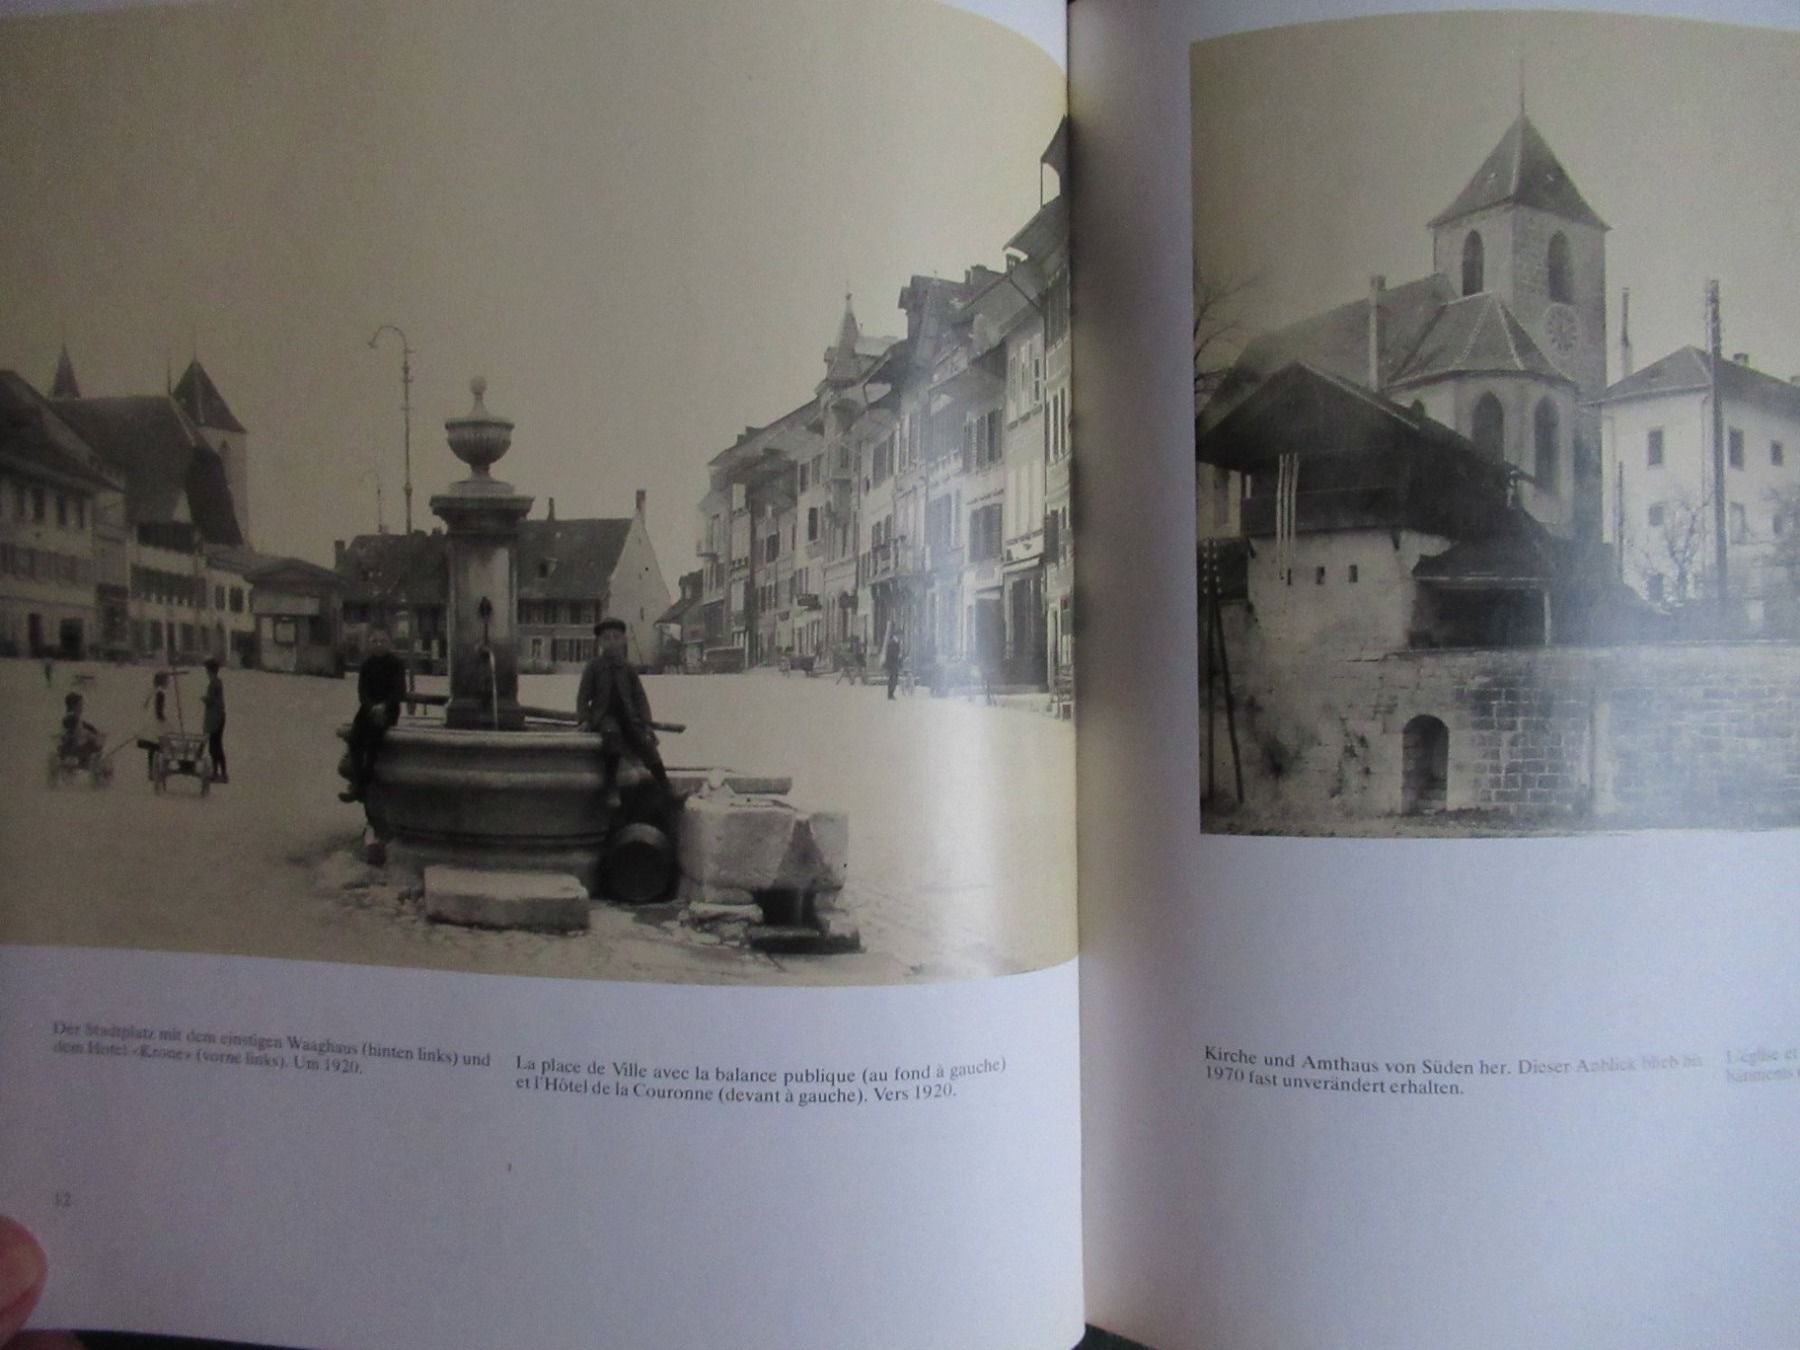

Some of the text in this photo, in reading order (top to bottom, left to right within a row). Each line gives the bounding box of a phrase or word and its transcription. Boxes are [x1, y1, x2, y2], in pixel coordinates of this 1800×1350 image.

[54, 1021, 81, 1036] Der
[159, 1027, 181, 1041] mit
[187, 1028, 216, 1043] dem
[220, 1030, 283, 1050] einstigen
[287, 1036, 357, 1056] Waaghaus
[362, 1041, 414, 1060] (hinten
[418, 1047, 459, 1067] links)
[463, 1053, 491, 1068] und
[54, 1041, 84, 1055] dem
[196, 1049, 241, 1066] (vorne
[294, 1055, 320, 1071] Um
[324, 1057, 363, 1075] 1920.
[1204, 1045, 1258, 1065] Kirche
[1264, 1053, 1296, 1068] und
[1301, 1055, 1379, 1074] Amthaus
[1385, 1061, 1416, 1075] von
[1422, 1059, 1474, 1076] Süden
[1479, 1059, 1512, 1076] her.
[1518, 1059, 1570, 1075] Dieser
[516, 1055, 1007, 1087] La place de Ville avec la balance publique (au fond à gauche)
[1205, 1065, 1464, 1096] 1970 fast unverändert erhalten.
[516, 1075, 957, 1108] et l'Hôtel de la Couronne (devant à gauche). Vers 1920.
